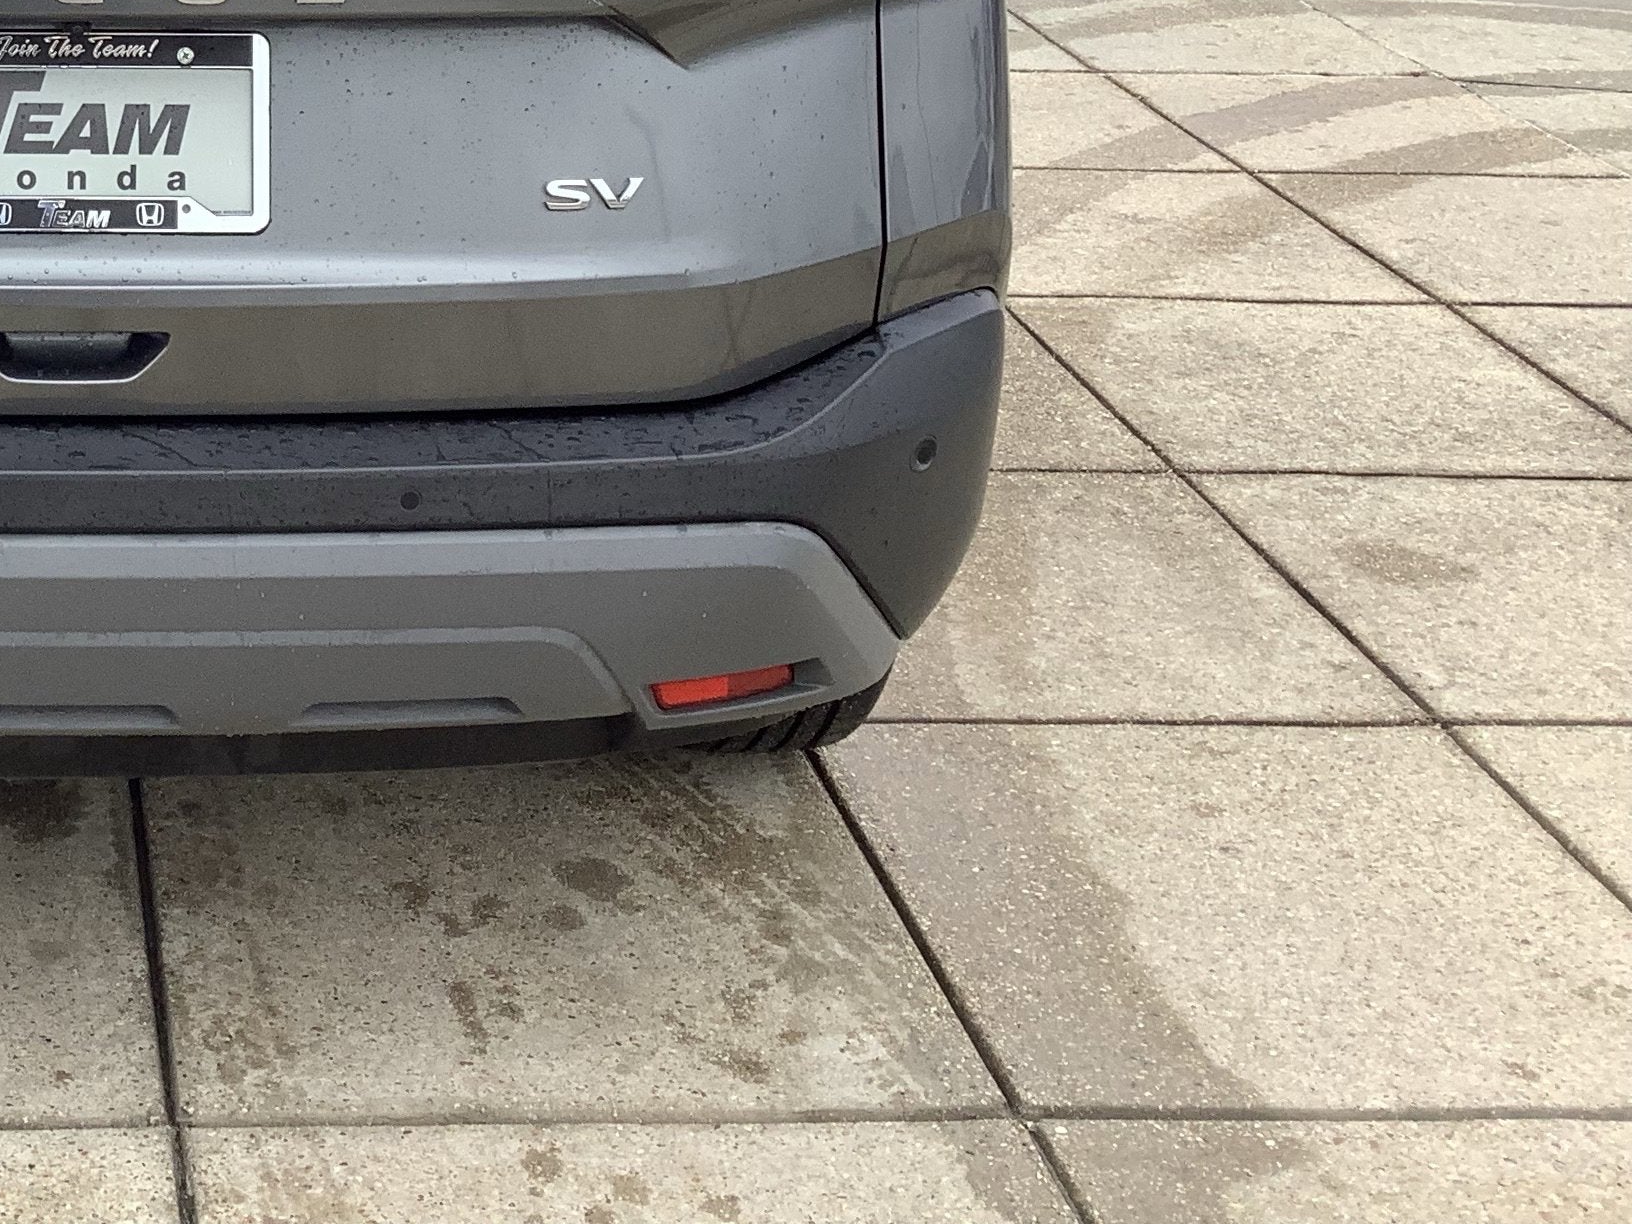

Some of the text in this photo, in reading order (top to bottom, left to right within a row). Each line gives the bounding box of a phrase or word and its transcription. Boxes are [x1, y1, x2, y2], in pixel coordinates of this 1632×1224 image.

[43, 36, 86, 59] The
[88, 35, 160, 59] Team!
[545, 177, 644, 210] SV
[37, 199, 112, 228] TEAM
